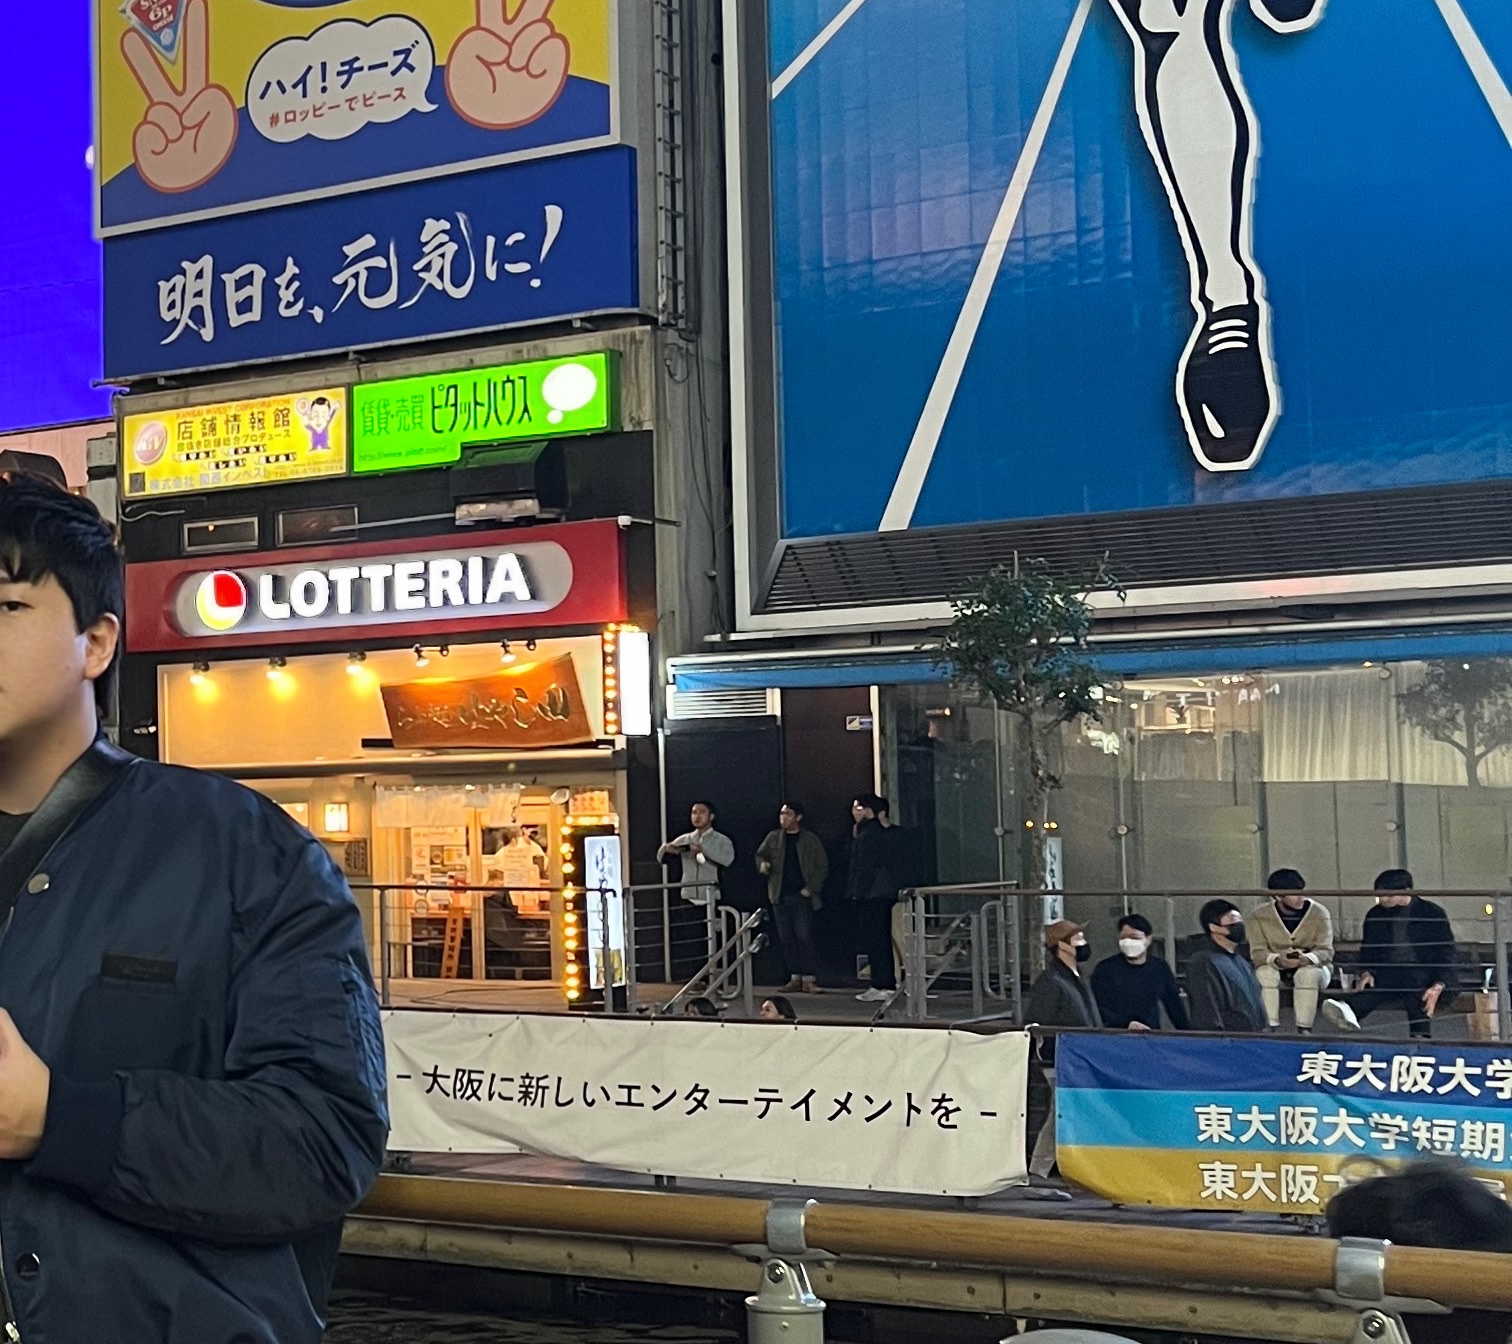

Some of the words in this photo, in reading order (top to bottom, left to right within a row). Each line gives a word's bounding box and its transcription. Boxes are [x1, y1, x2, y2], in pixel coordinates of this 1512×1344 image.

[176, 408, 291, 441] 店舗情報館
[430, 374, 533, 434] ピタットハウス
[259, 551, 533, 621] LOTTERIA
[1194, 1103, 1512, 1163] 東大阪大学短期
